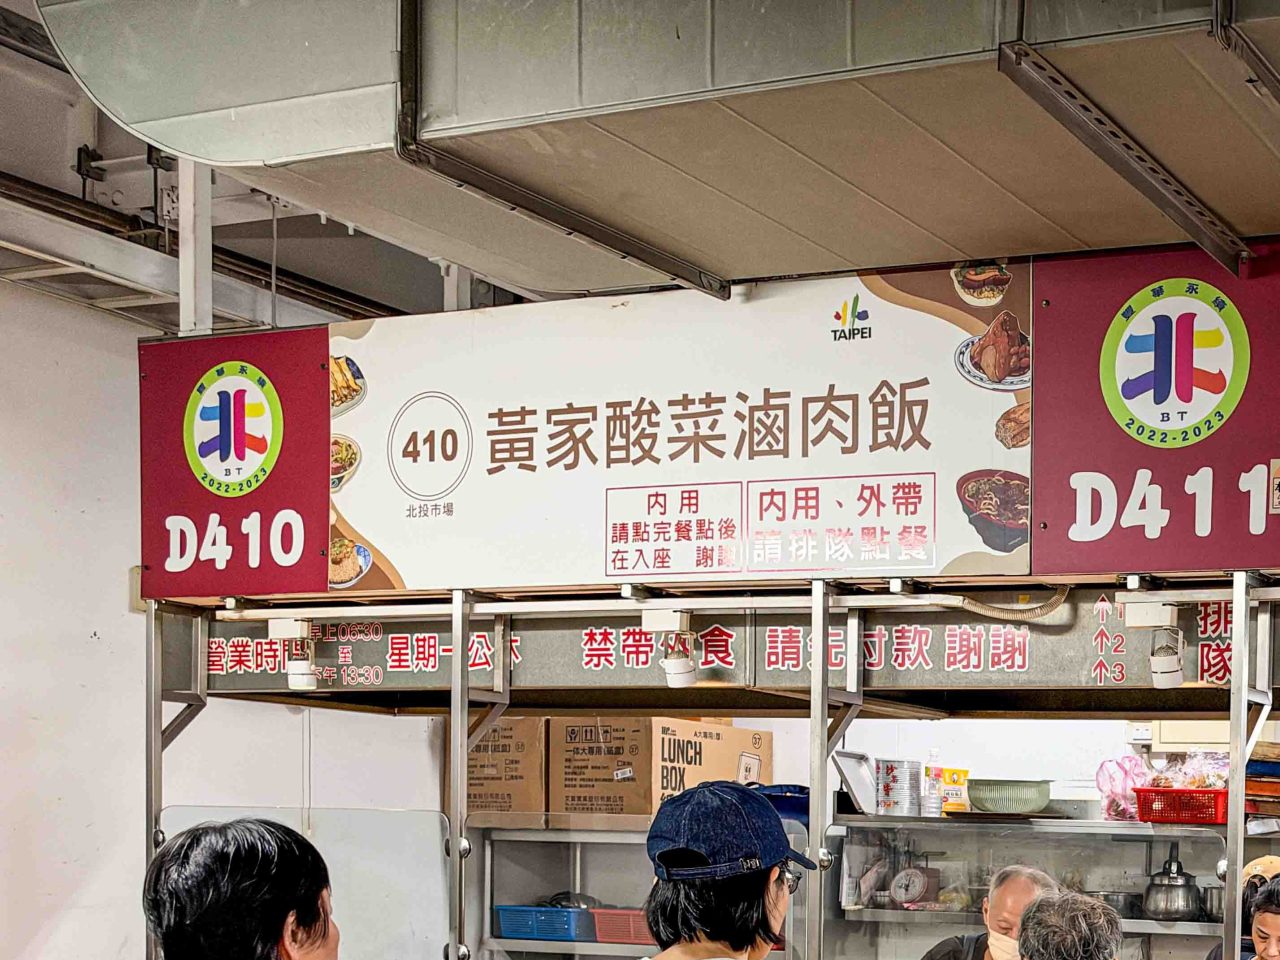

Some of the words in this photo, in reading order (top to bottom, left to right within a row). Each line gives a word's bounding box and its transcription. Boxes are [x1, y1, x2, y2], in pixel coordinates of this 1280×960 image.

[830, 326, 872, 341] TAIPEI
[485, 376, 932, 477] 黃家酸菜滷肉飯
[1125, 410, 1225, 444] 2022-2023
[401, 428, 459, 464] 410
[201, 467, 268, 494] 2022-2023
[405, 502, 455, 519] 北投市場
[1067, 463, 1269, 542] D411
[165, 508, 304, 572] D410
[611, 517, 737, 545] 請點完餐點後
[611, 548, 672, 572] 在入座
[338, 645, 353, 665] 至
[943, 623, 1030, 672] 謝謝
[1112, 633, 1126, 655] 2
[1111, 661, 1126, 684] 3
[660, 736, 703, 767] LUNCH
[660, 765, 686, 792] BOX
